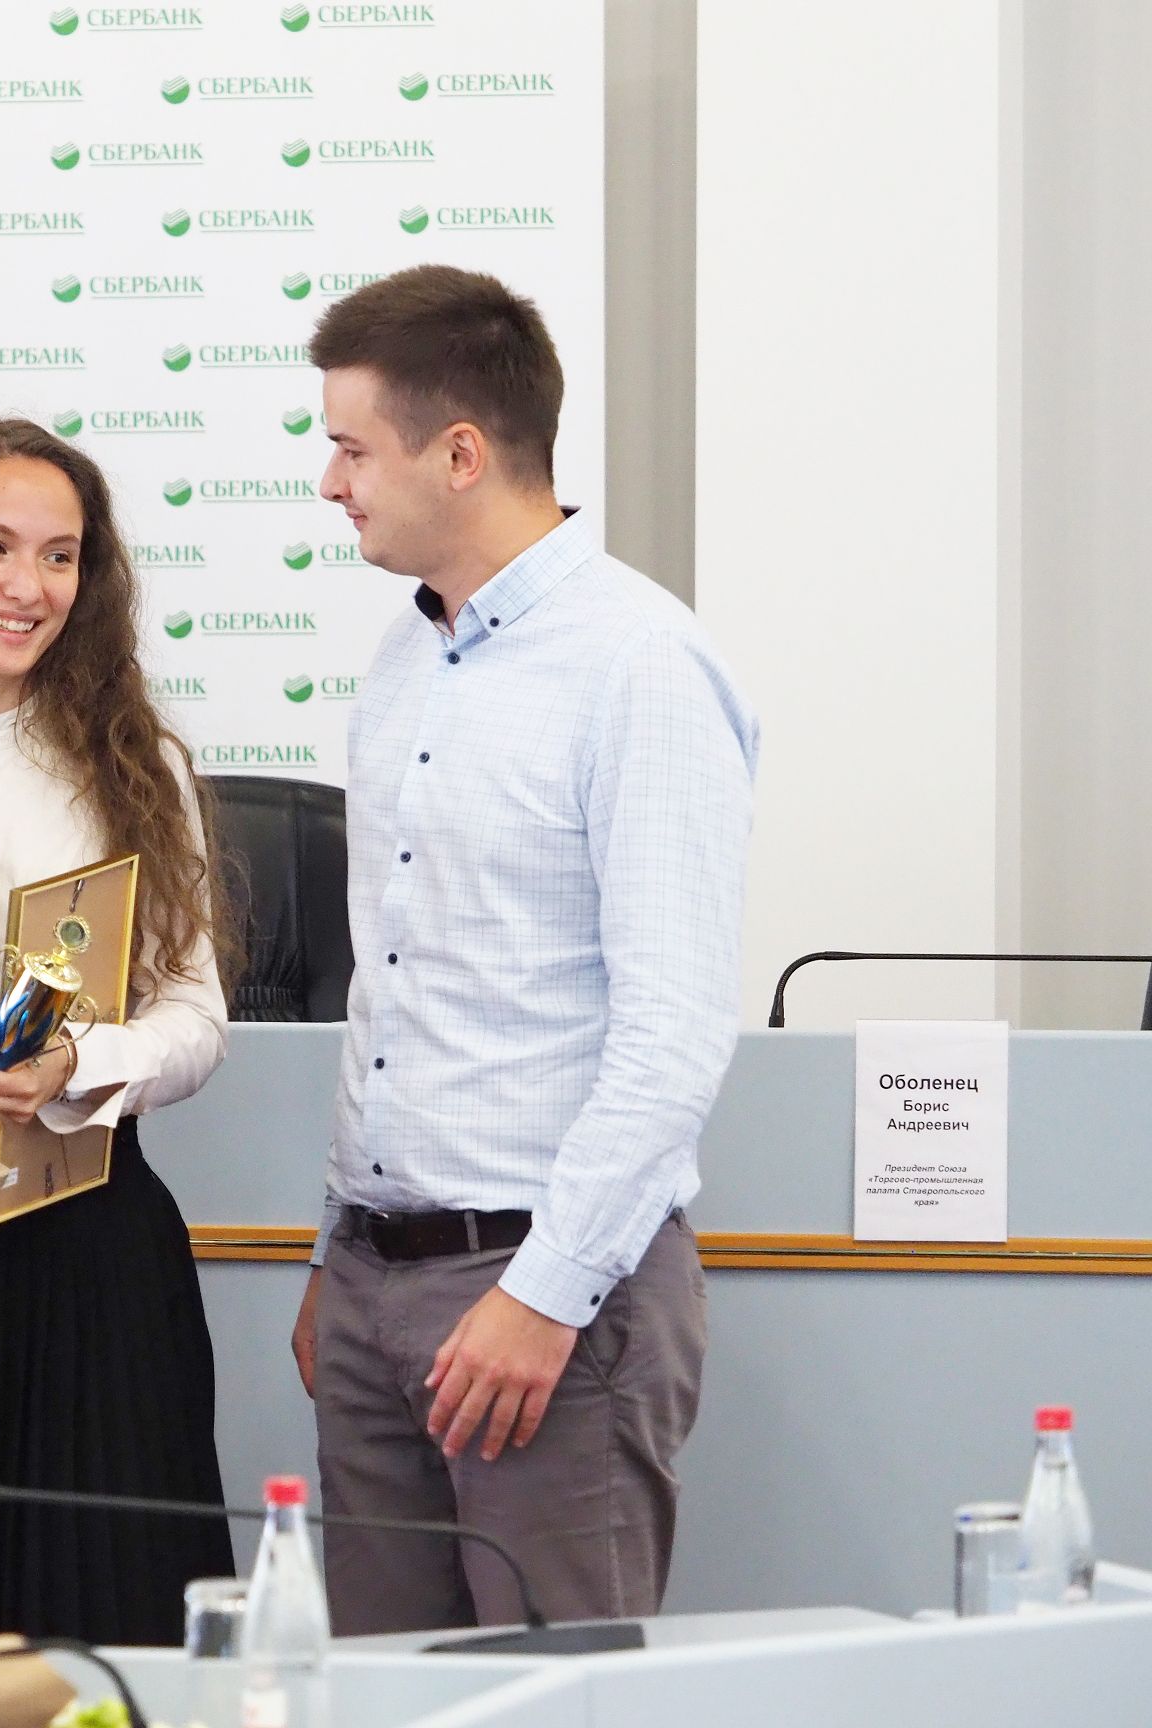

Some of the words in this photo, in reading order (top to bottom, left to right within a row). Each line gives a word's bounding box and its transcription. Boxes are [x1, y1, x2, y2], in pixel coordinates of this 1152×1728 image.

[86, 7, 203, 26] СБЕРБАНК
[317, 4, 435, 23] СБЕРБАНК
[197, 75, 314, 95] СБЕРБАНК
[435, 71, 554, 92] СБЕРБАНК
[87, 141, 204, 161] СБЕРБАНК
[317, 138, 435, 158] СБЕРБАНК
[198, 207, 315, 227] СБЕРБАНК
[436, 205, 555, 225] СБЕРБАНК
[88, 274, 205, 294] СБЕРБАНК
[89, 409, 205, 428] СБЕРБАНК
[198, 478, 316, 497] СБЕРБАНК
[199, 610, 317, 630] СБЕРБАНК
[200, 743, 317, 763] СБЕРБАНК
[878, 1073, 979, 1093] Оболенец
[903, 1099, 950, 1115] Борис
[887, 1118, 969, 1133] Андреевич
[884, 1164, 936, 1174] Президент
[938, 1164, 967, 1173] Союза
[866, 1187, 900, 1195] палата
[902, 1186, 985, 1196] Ставропольского
